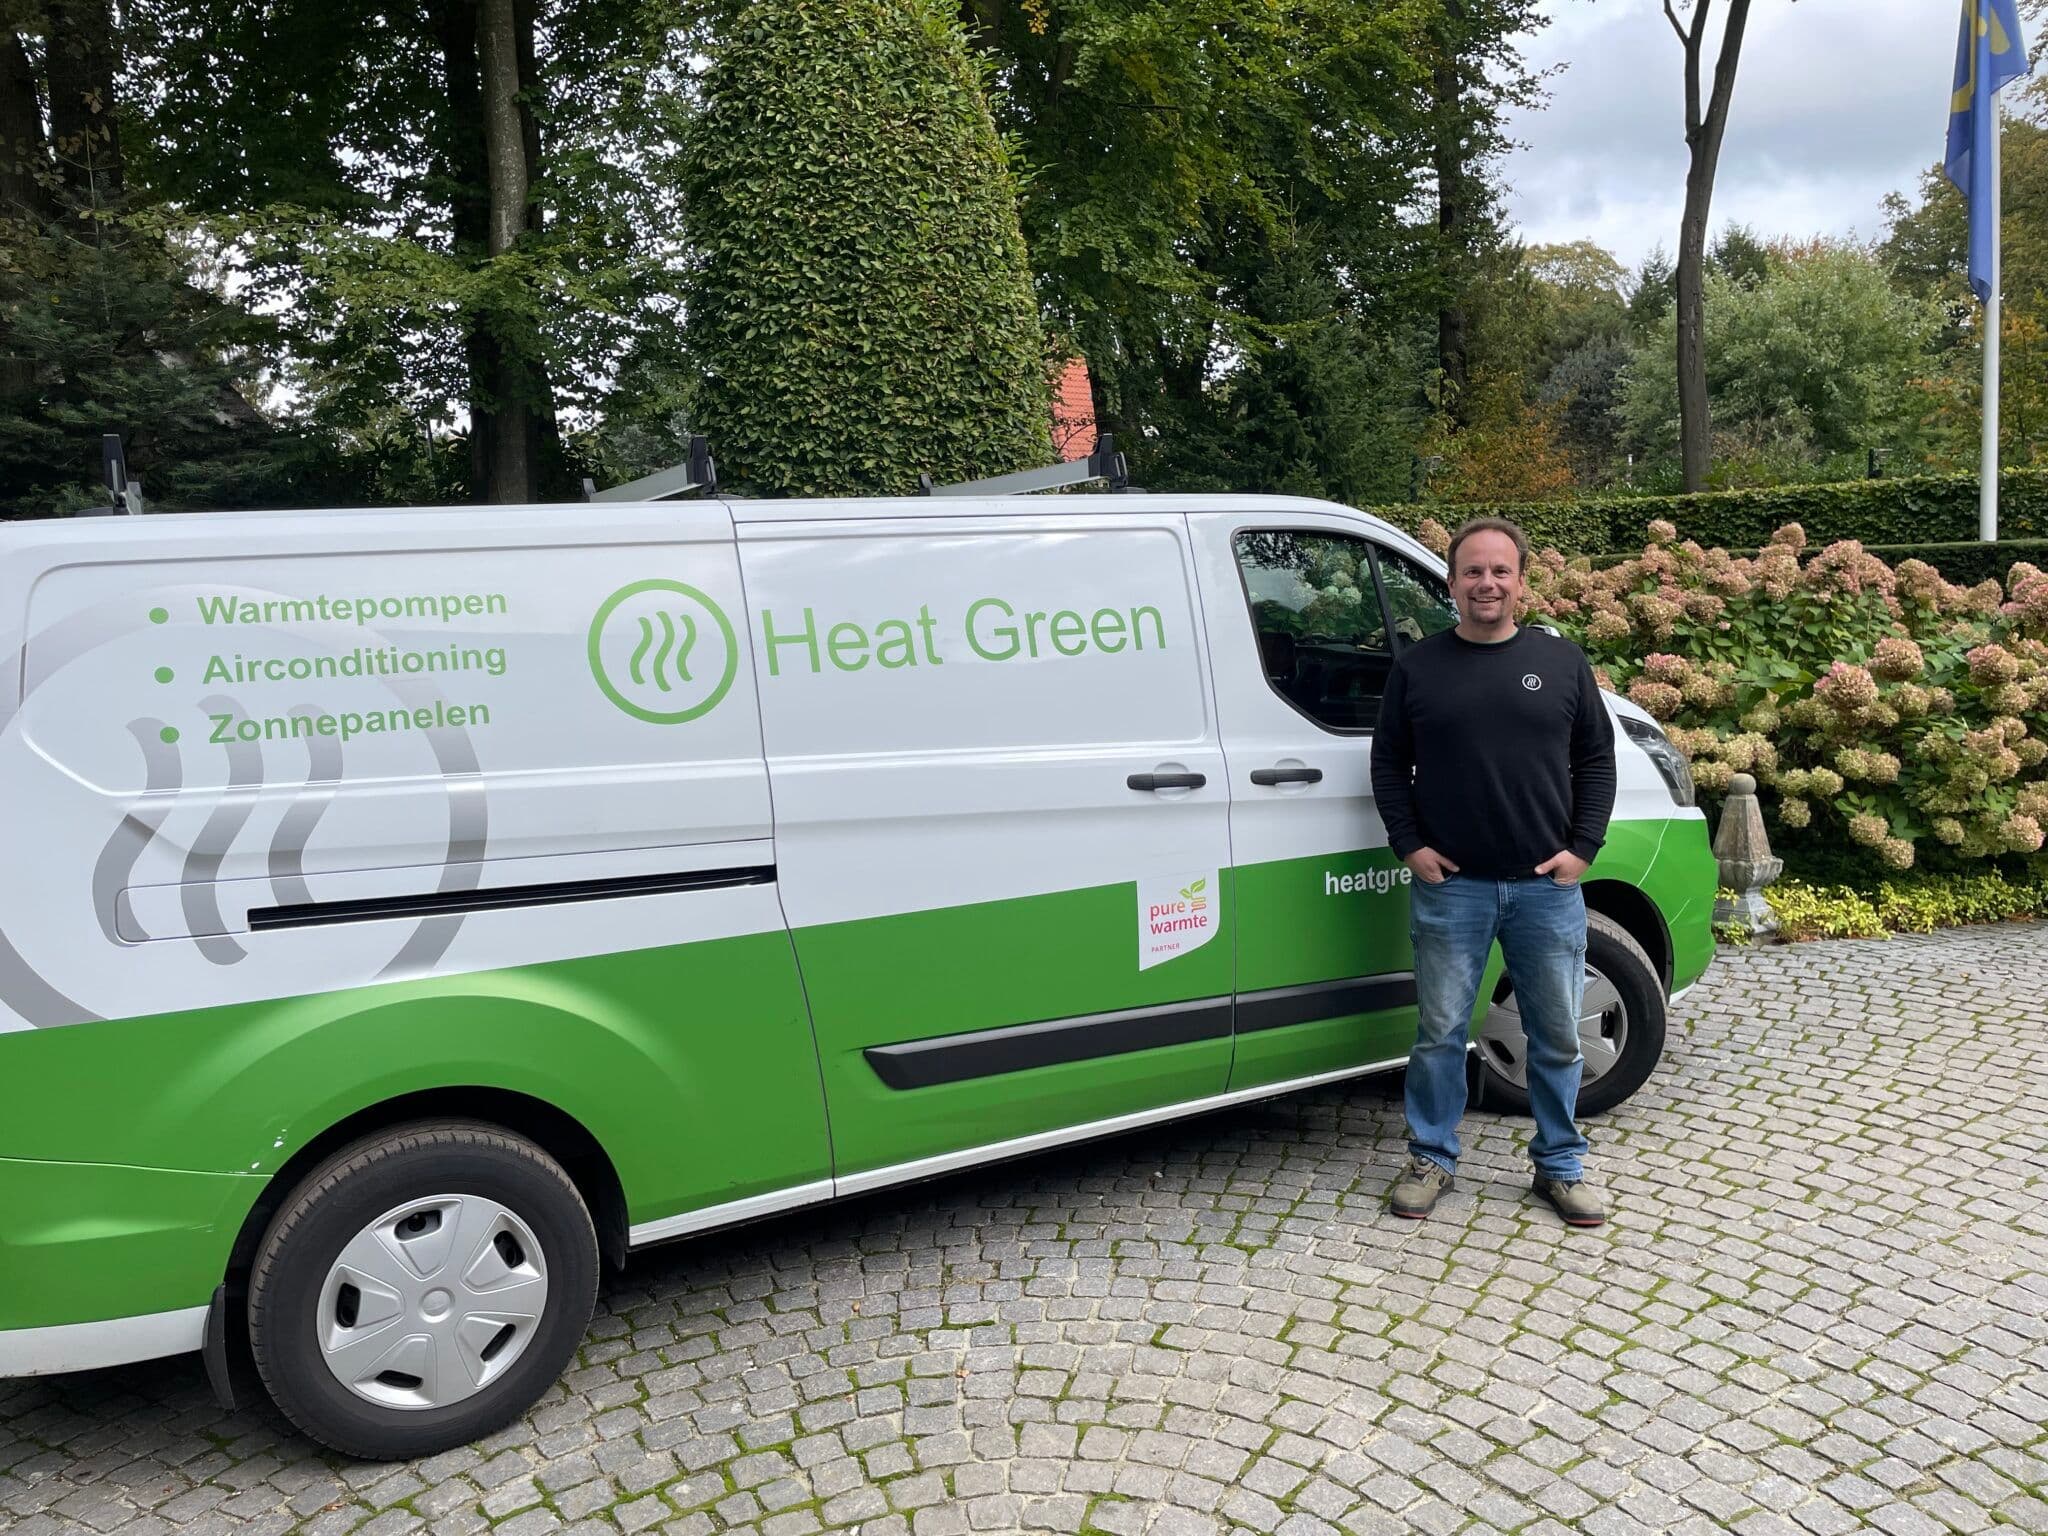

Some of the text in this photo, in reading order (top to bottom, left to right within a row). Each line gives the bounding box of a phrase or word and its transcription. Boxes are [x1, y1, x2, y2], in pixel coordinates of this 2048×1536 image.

[198, 590, 507, 625] Warmtepompen
[762, 598, 1167, 676] Heat Green
[202, 643, 508, 686] Airconditioning
[208, 699, 491, 744] Zonnepanelen
[1150, 901, 1185, 921] pure
[1150, 914, 1207, 935] warmte
[1151, 943, 1180, 952] PARTNER
